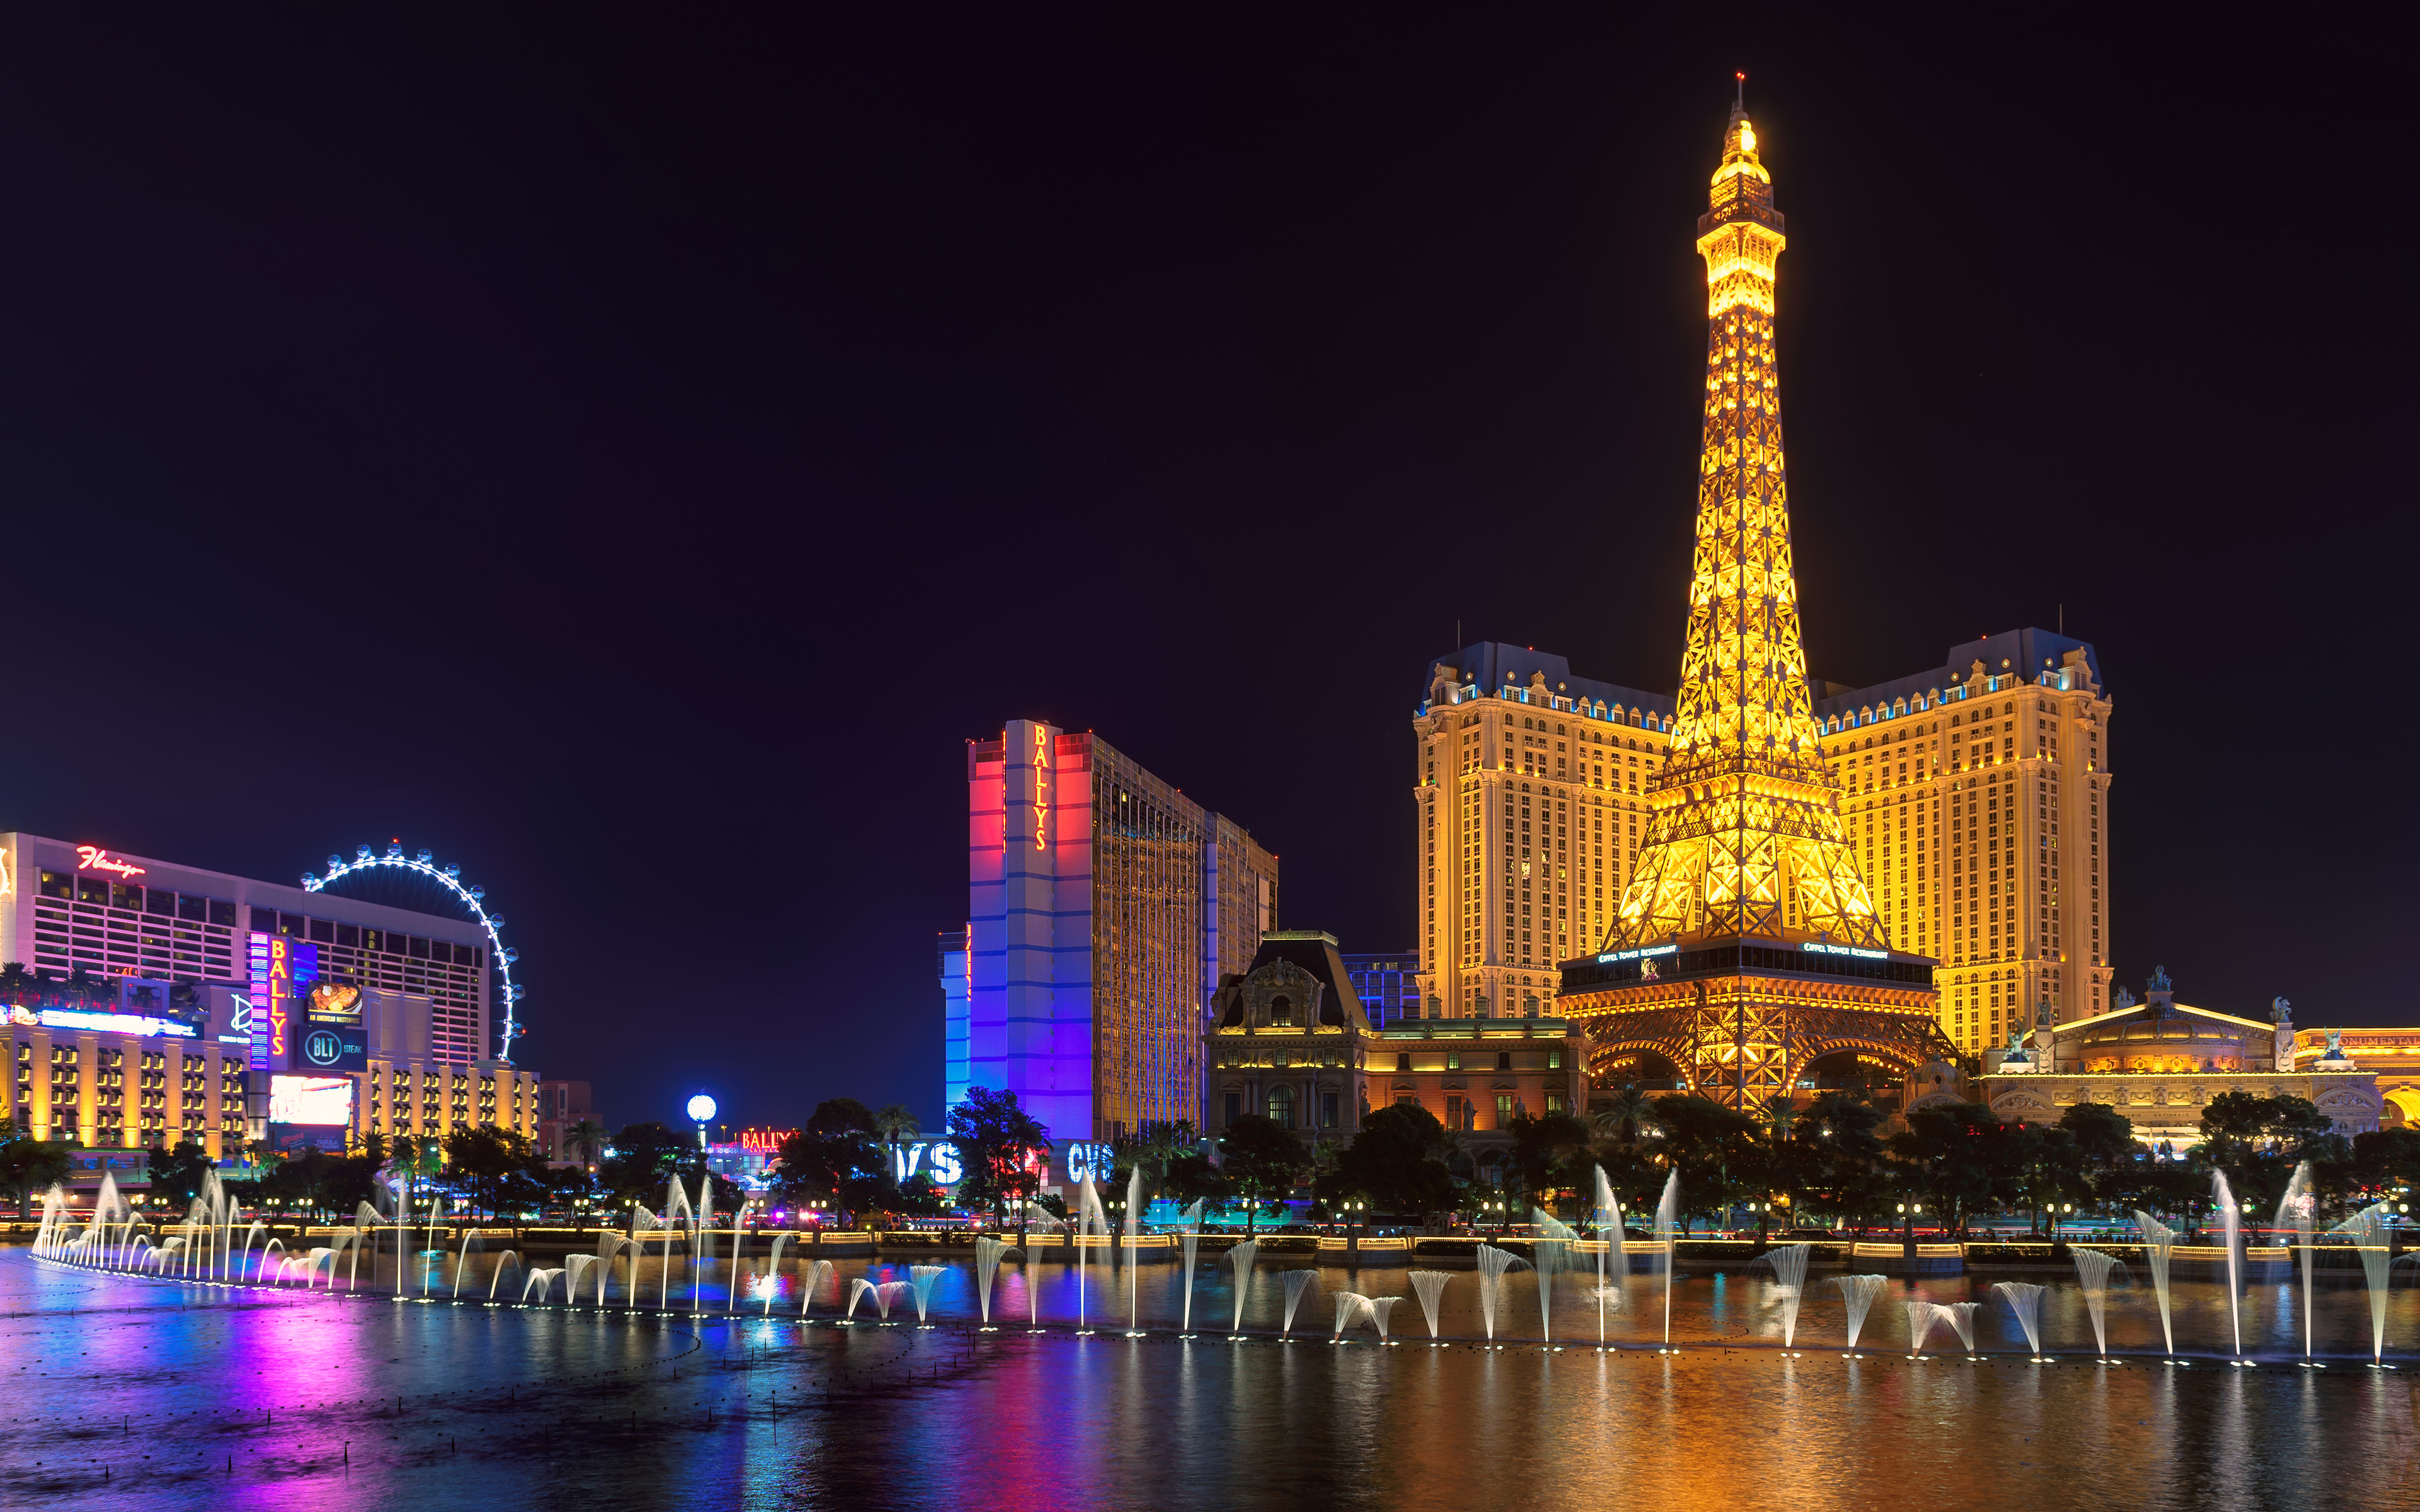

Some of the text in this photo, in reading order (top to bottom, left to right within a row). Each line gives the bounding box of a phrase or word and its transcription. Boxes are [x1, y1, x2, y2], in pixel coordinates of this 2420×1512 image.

[1032, 724, 1049, 851] BALLYS
[76, 845, 146, 879] Flamingo
[269, 939, 288, 1056] BALLYS
[313, 1037, 362, 1057] BLT STEAK
[2339, 1037, 2420, 1046] ONUMENTAL
